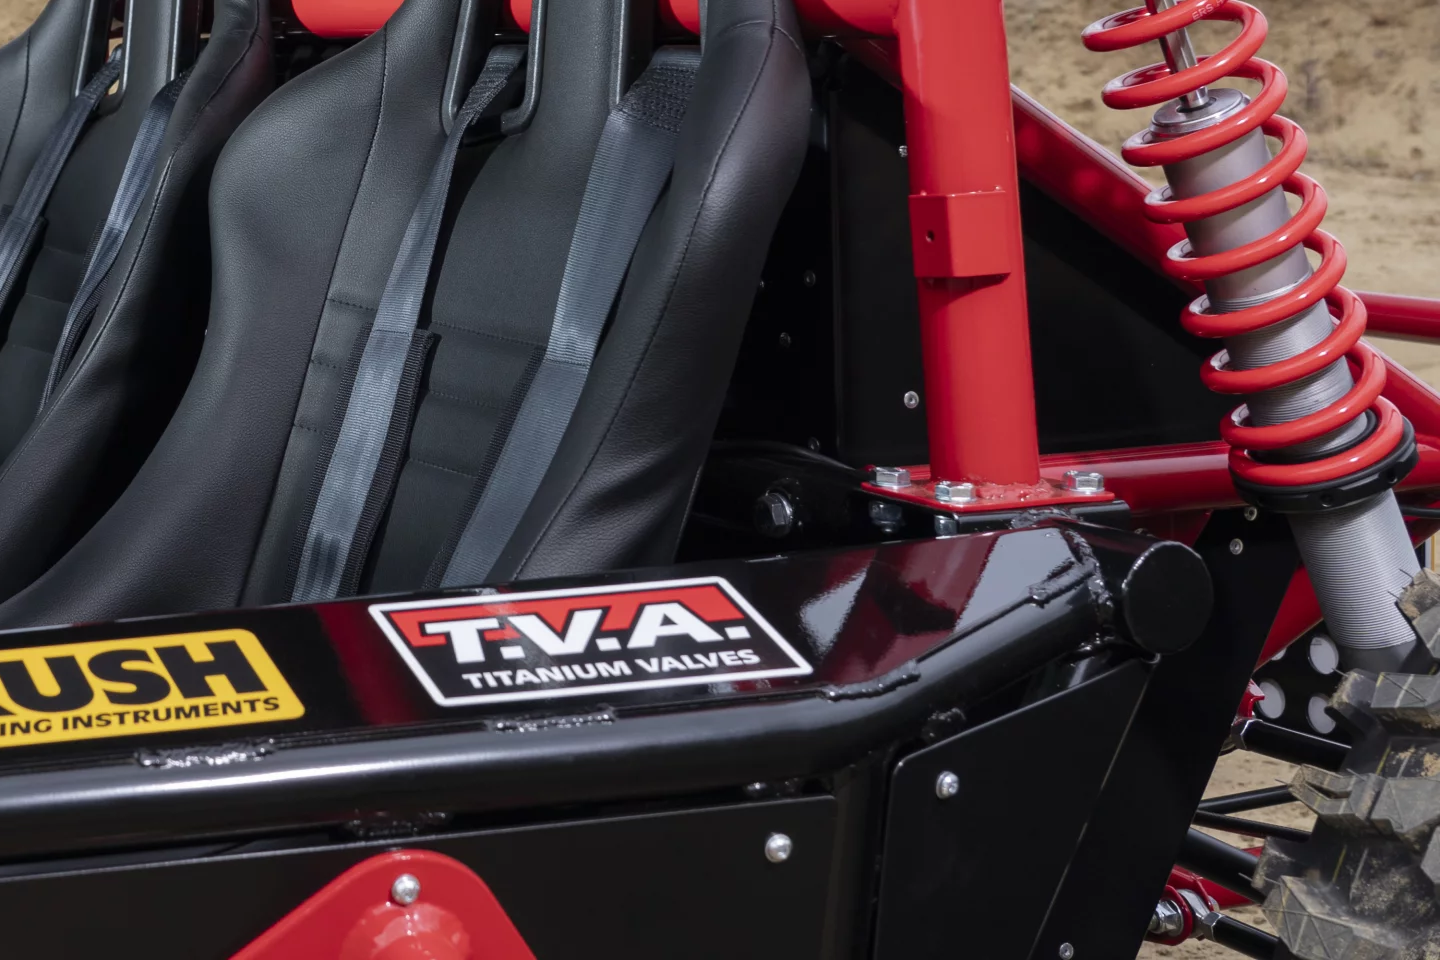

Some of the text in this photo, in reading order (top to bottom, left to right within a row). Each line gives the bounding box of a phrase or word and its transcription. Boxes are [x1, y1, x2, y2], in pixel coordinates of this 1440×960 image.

[1192, 3, 1214, 21] ERS
[425, 602, 751, 663] T.V.A.
[462, 649, 761, 690] TITANIUM VALVES
[62, 697, 280, 730] INSTRUMENTS
